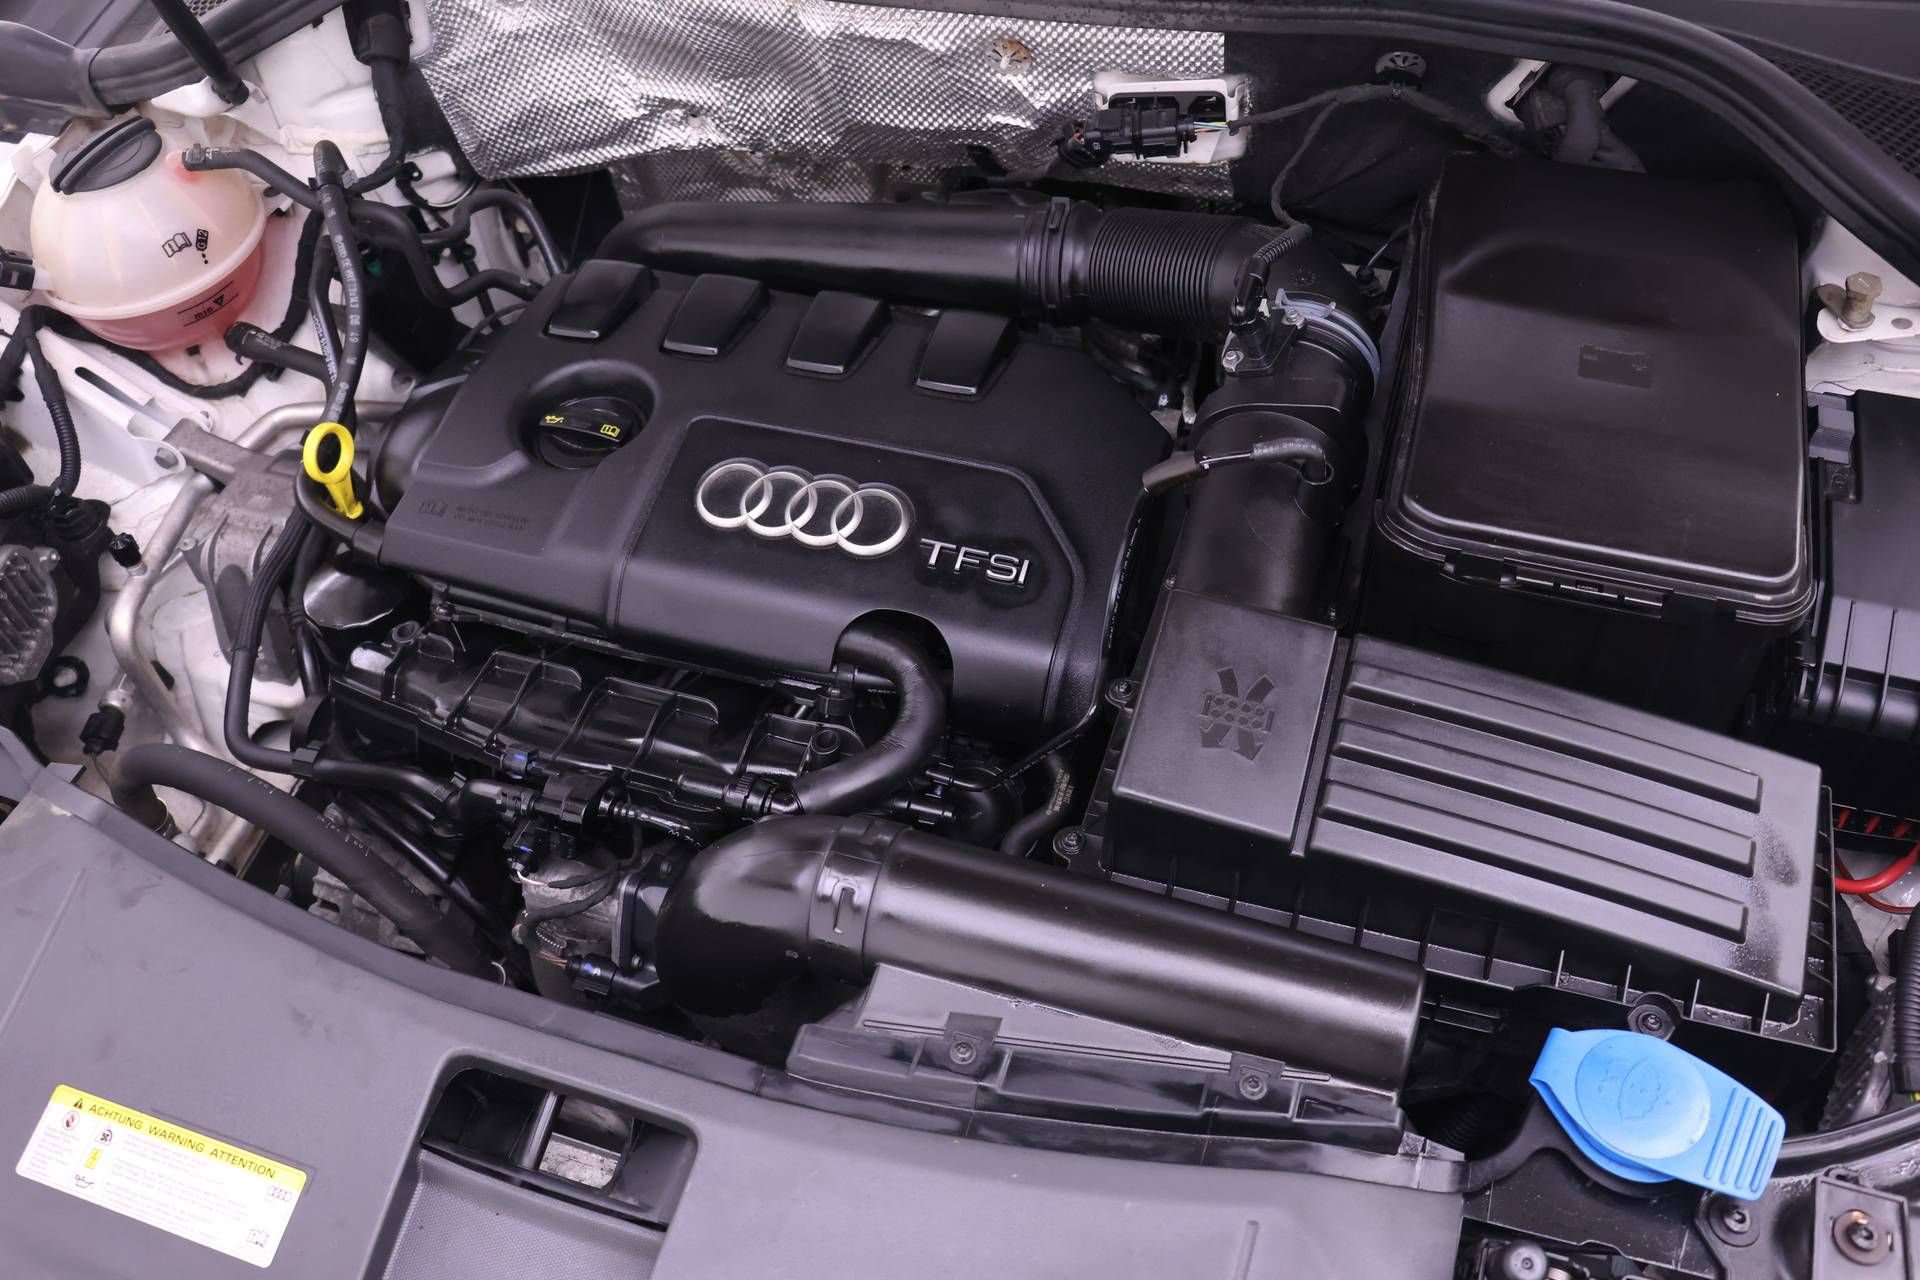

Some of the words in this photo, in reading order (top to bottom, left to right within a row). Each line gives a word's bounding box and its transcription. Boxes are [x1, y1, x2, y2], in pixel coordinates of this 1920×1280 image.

[196, 229, 208, 251] G12
[194, 306, 214, 321] min
[920, 538, 1029, 588] TFSI
[89, 1104, 144, 1130] ACHTUNG
[148, 1124, 205, 1153] WARNING
[209, 1147, 277, 1179] ATTENTION
